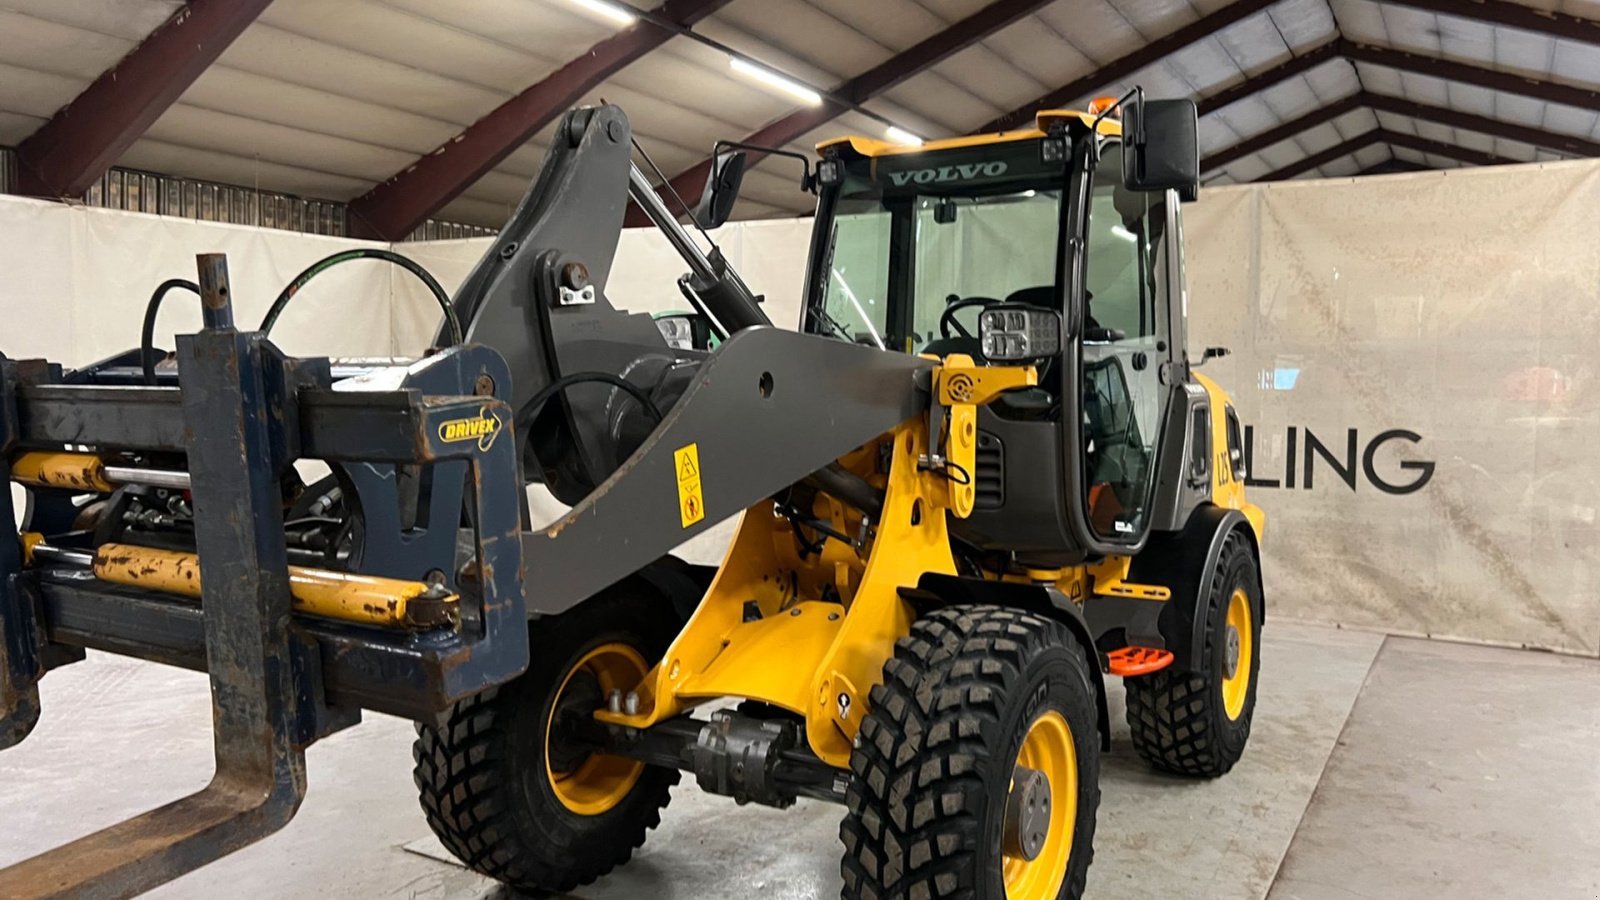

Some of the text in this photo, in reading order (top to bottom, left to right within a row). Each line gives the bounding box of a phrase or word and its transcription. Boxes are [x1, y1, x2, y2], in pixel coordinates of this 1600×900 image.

[888, 161, 1008, 187] VOLVO
[445, 418, 495, 440] DRIVEX
[1244, 425, 1435, 495] LING
